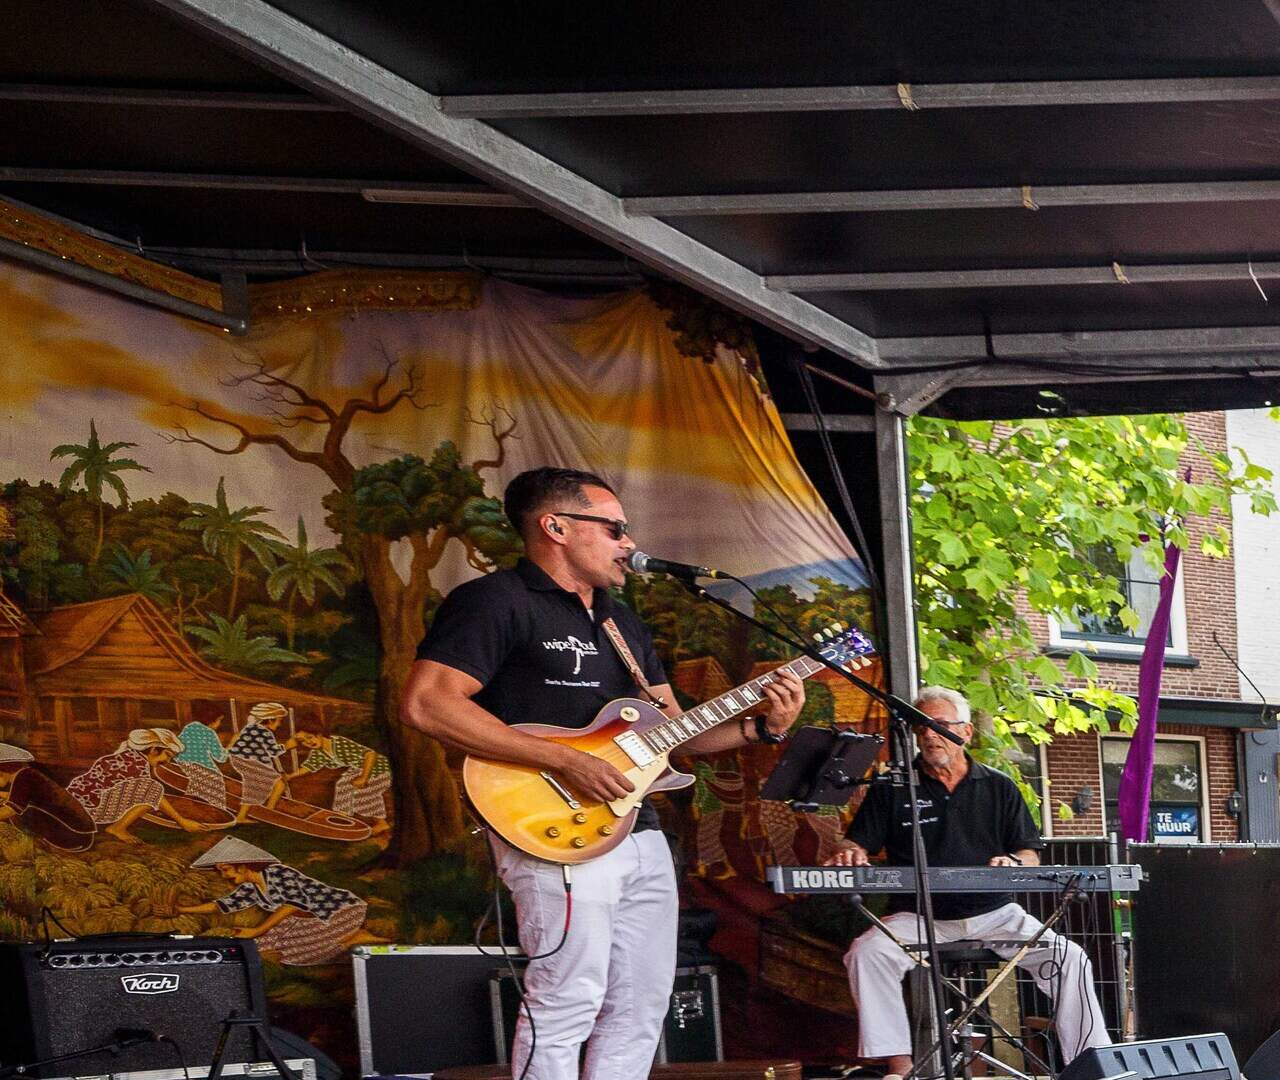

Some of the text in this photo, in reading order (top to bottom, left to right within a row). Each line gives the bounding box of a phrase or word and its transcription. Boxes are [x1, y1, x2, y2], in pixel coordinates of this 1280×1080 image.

[1156, 812, 1173, 823] TE
[1156, 822, 1192, 833] HUUR
[792, 870, 855, 889] KORG
[130, 976, 173, 991] Koch
